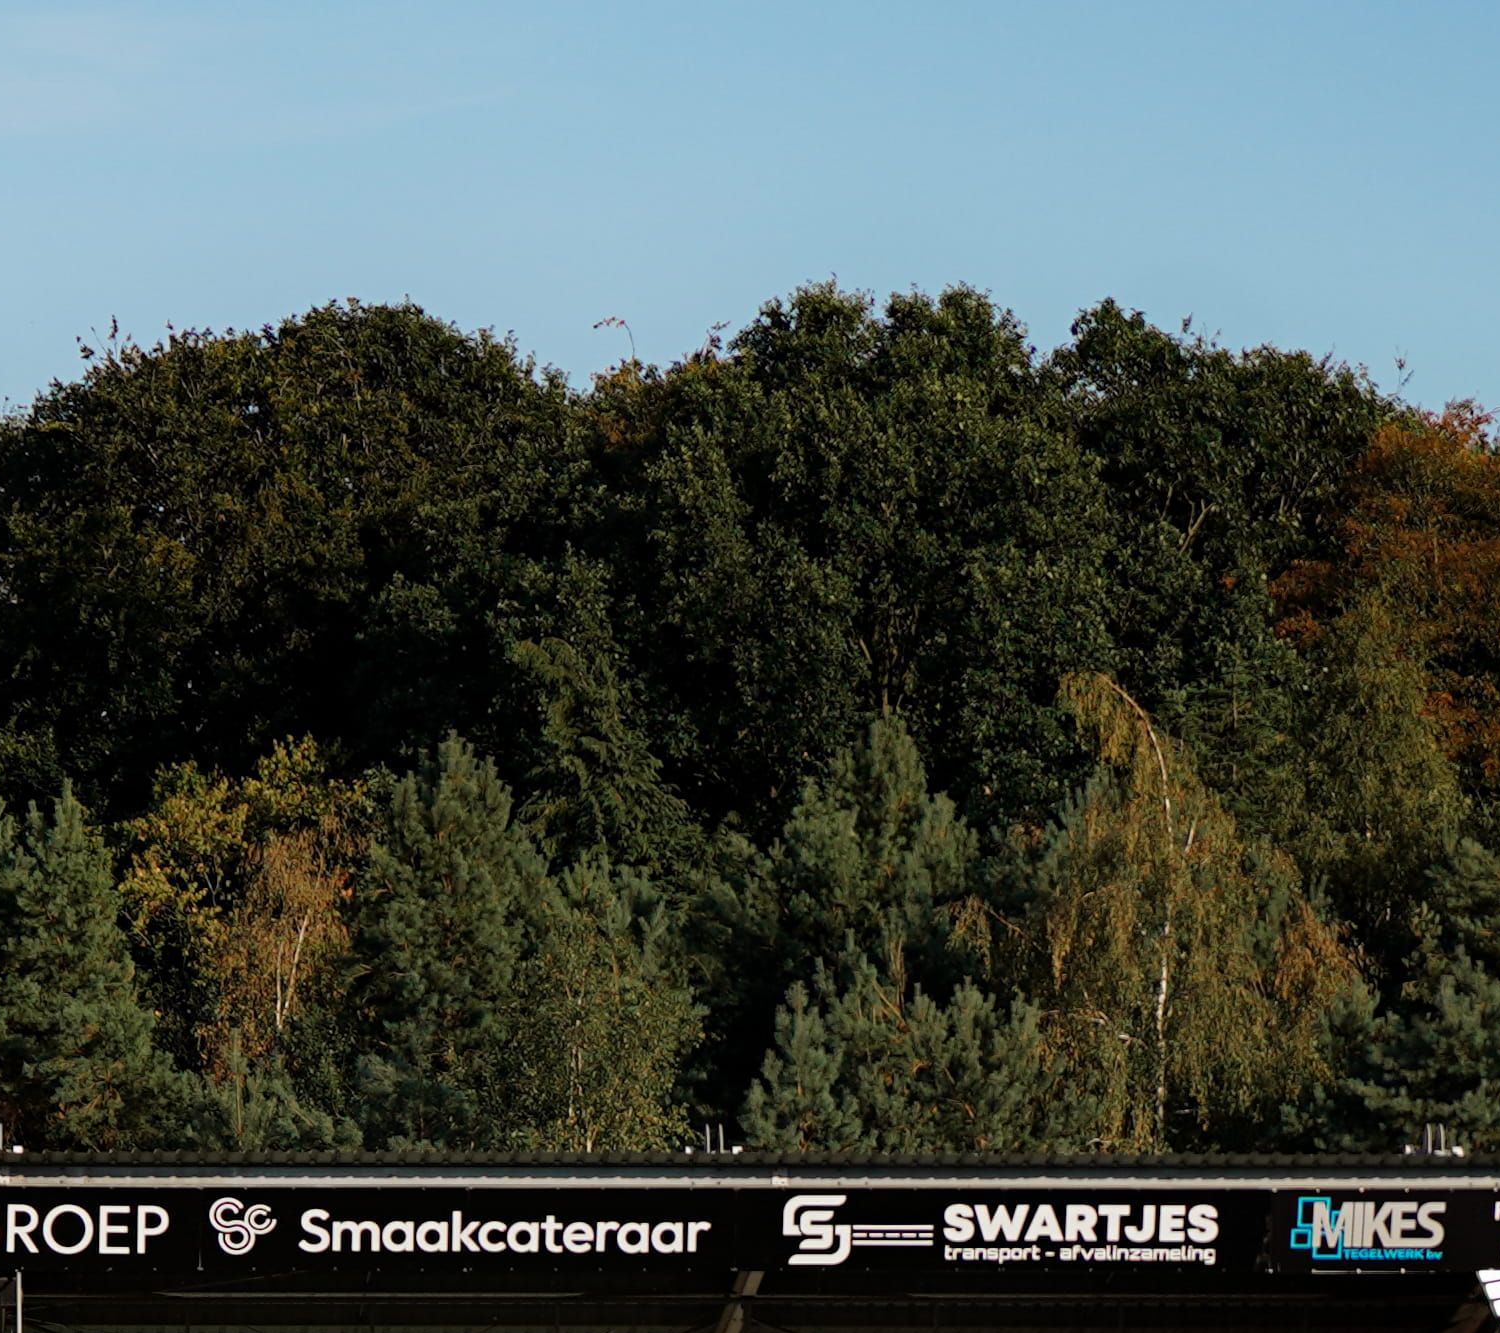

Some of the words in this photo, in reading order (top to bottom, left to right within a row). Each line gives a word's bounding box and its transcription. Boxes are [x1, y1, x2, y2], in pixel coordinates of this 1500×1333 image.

[299, 1209, 711, 1253] Smaakcateraar
[943, 1204, 1218, 1243] SWARTJES
[1312, 1201, 1446, 1248] MIKES
[942, 1243, 1041, 1264] transport
[1060, 1243, 1216, 1264] afvalinzameling
[1343, 1249, 1424, 1260] TEGELWERK
